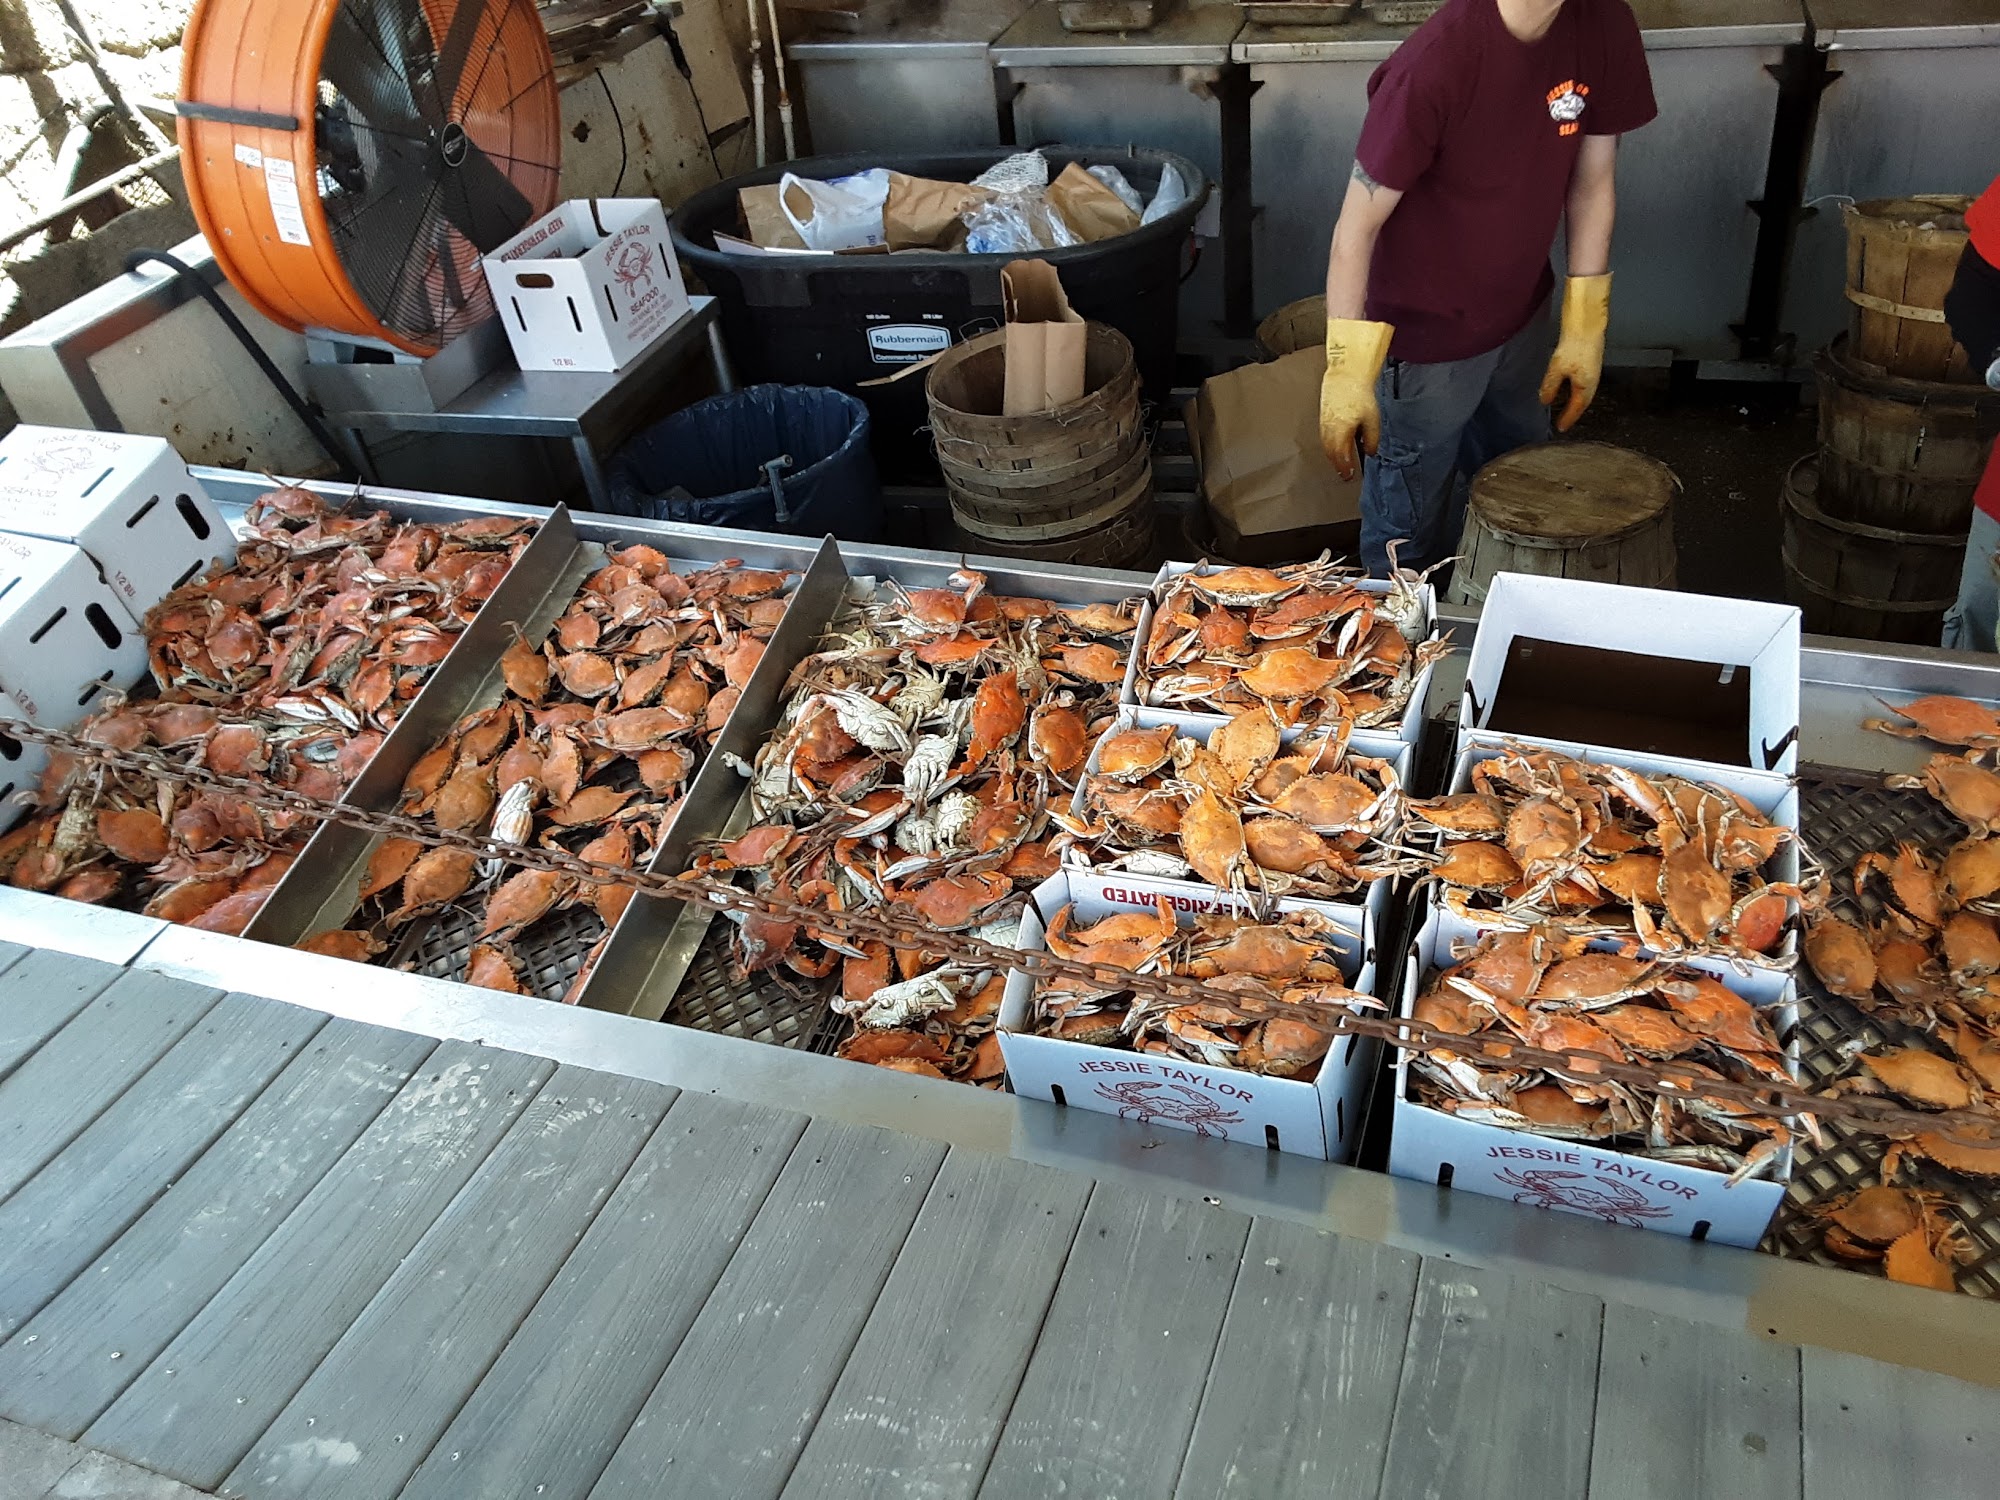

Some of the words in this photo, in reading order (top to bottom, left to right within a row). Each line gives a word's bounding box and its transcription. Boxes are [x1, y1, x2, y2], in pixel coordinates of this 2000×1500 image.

[605, 234, 624, 266] JESSIE
[624, 224, 651, 238] TAYLOR
[630, 286, 659, 315] SEAFOOD
[875, 335, 944, 344] Rubbermaid
[1078, 1060, 1152, 1075] JESSIE
[1158, 1065, 1254, 1103] TAYLOR
[1486, 1146, 1580, 1165] JESSIE
[1591, 1157, 1699, 1200] TAYLOR
